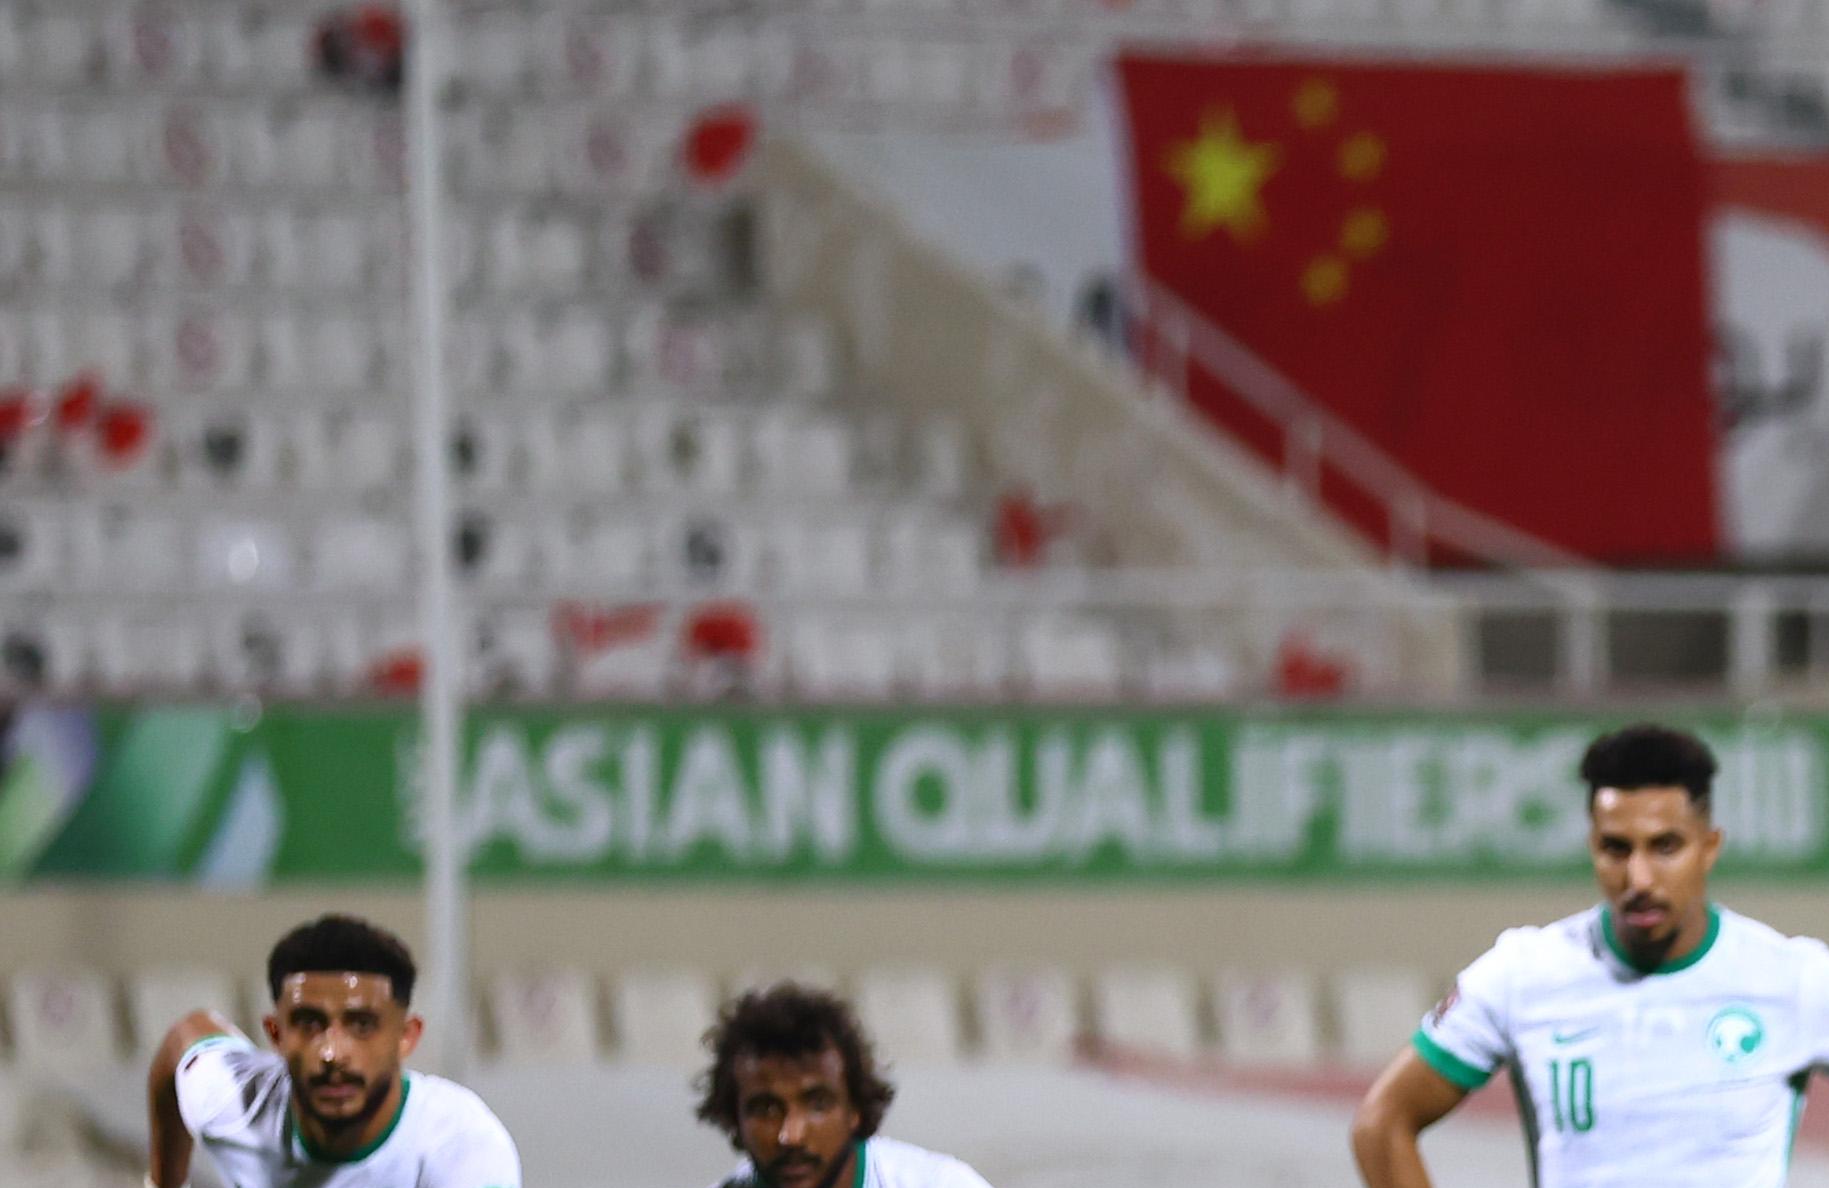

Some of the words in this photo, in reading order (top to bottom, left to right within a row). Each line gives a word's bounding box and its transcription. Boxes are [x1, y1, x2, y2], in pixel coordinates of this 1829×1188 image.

[458, 722, 857, 863] ASIAN
[872, 724, 1604, 863] QUALIFIERS
[1548, 1057, 1595, 1133] 10
